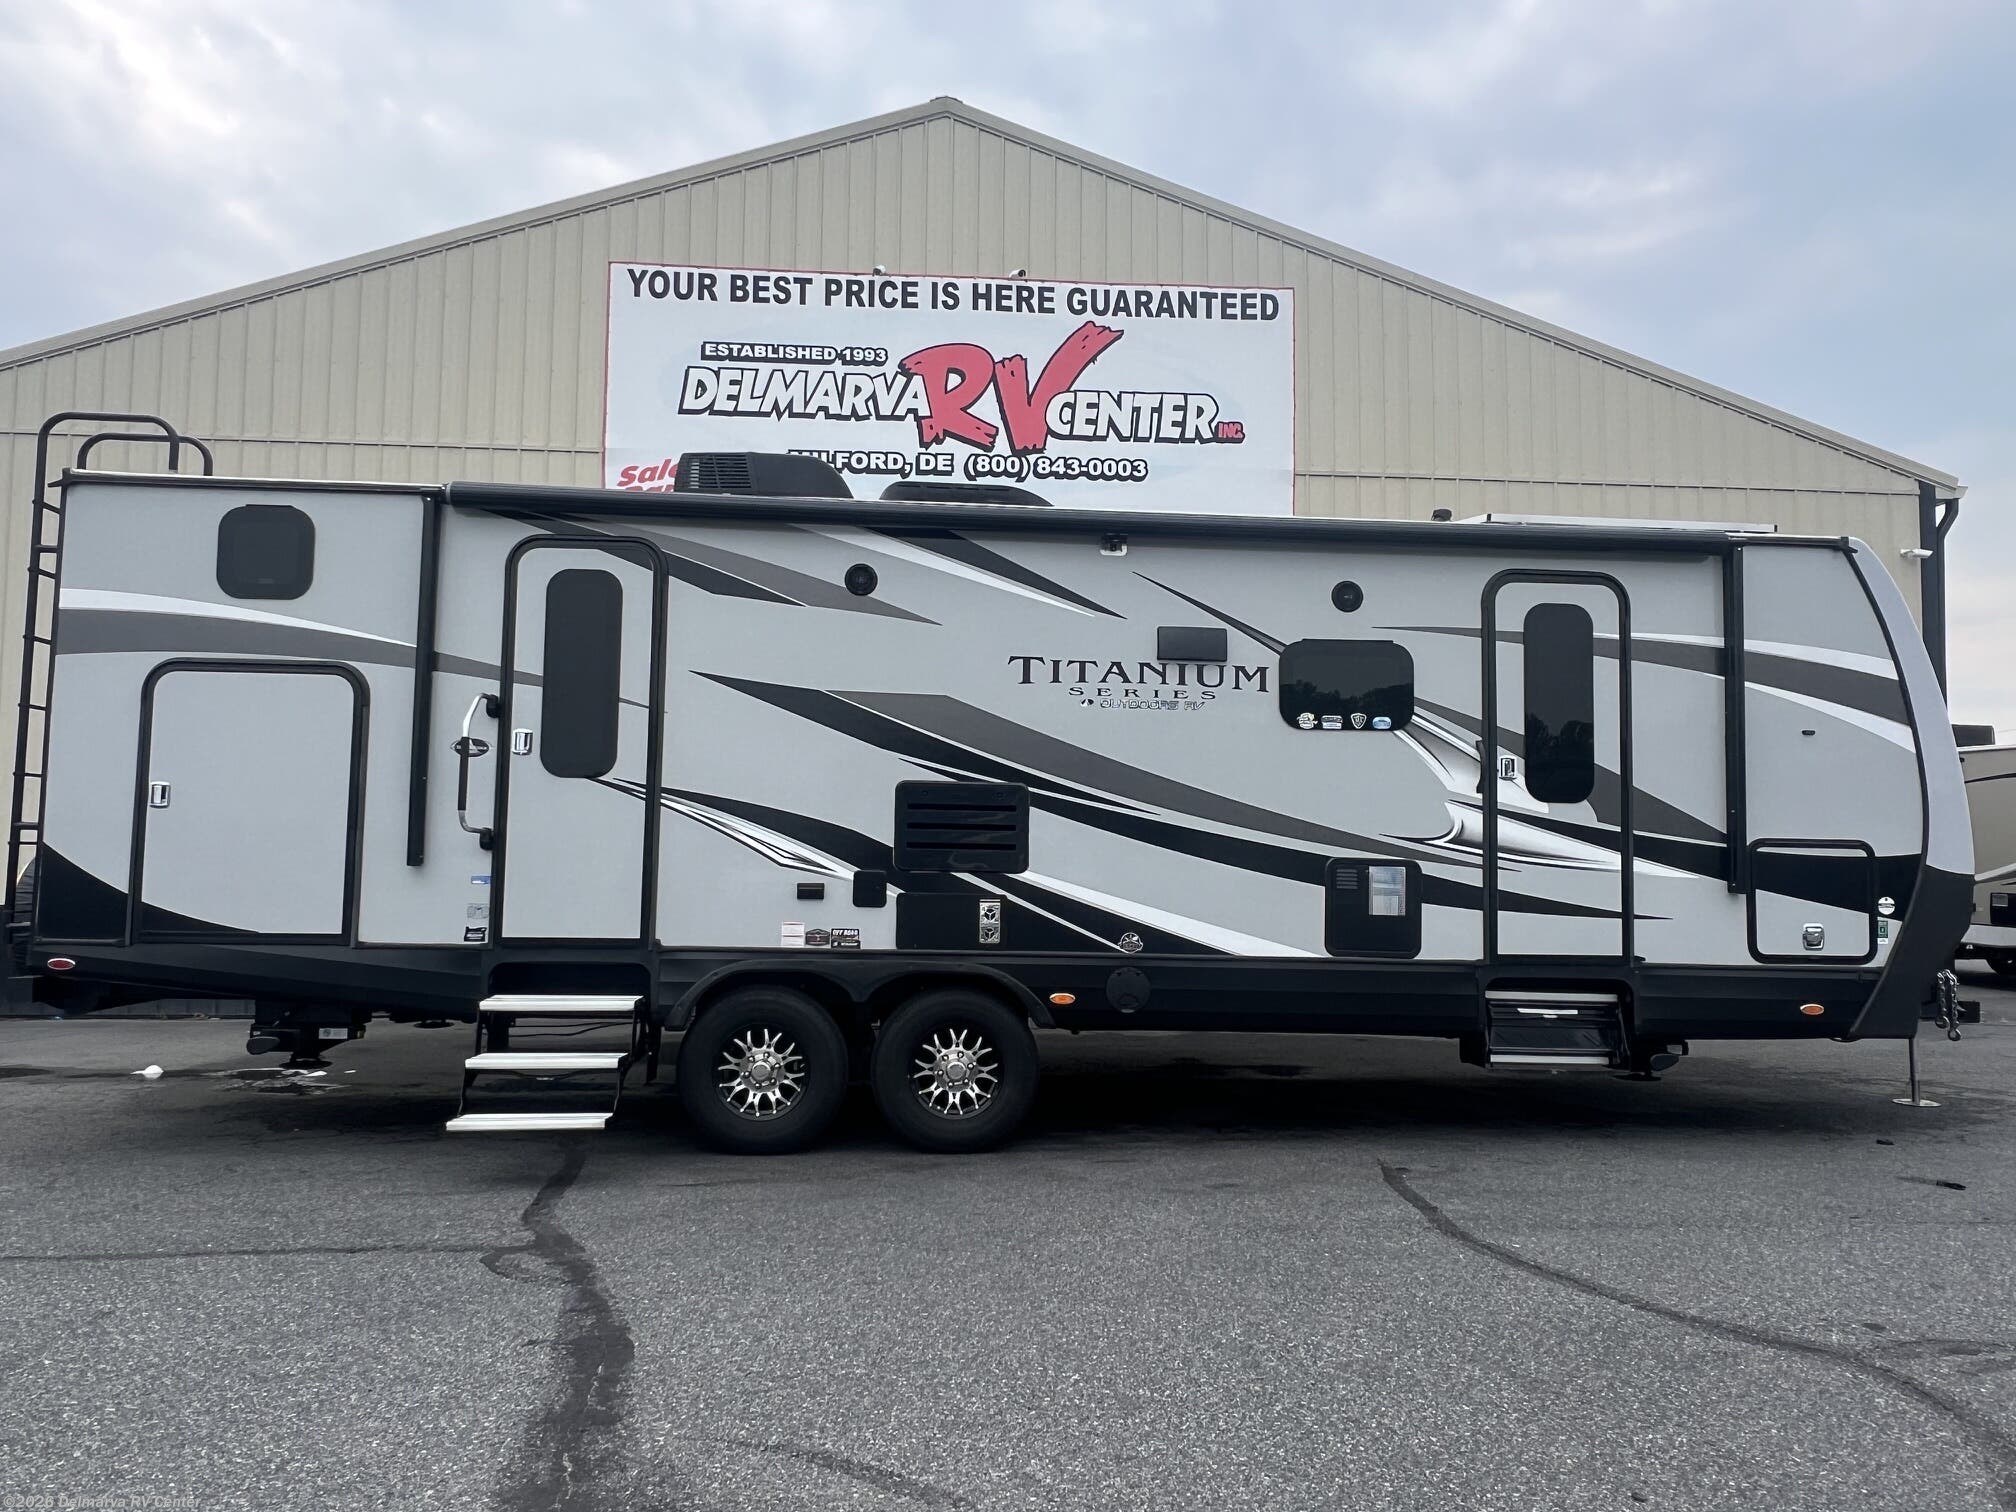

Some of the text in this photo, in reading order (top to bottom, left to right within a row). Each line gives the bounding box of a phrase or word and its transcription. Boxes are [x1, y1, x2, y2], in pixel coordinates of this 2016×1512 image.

[627, 268, 1280, 321] YOUR BEST PRICE IS HERE GUARANTEED
[703, 342, 888, 363] ESTABLISHED 1993
[679, 366, 932, 419] DELMARVA
[899, 320, 1124, 455] RV
[1045, 390, 1219, 442] CENTER
[788, 450, 1147, 479] LFORD, DE (800) 843-0003
[1007, 655, 1270, 693] TITANIUM
[1068, 686, 1217, 700] SERIES
